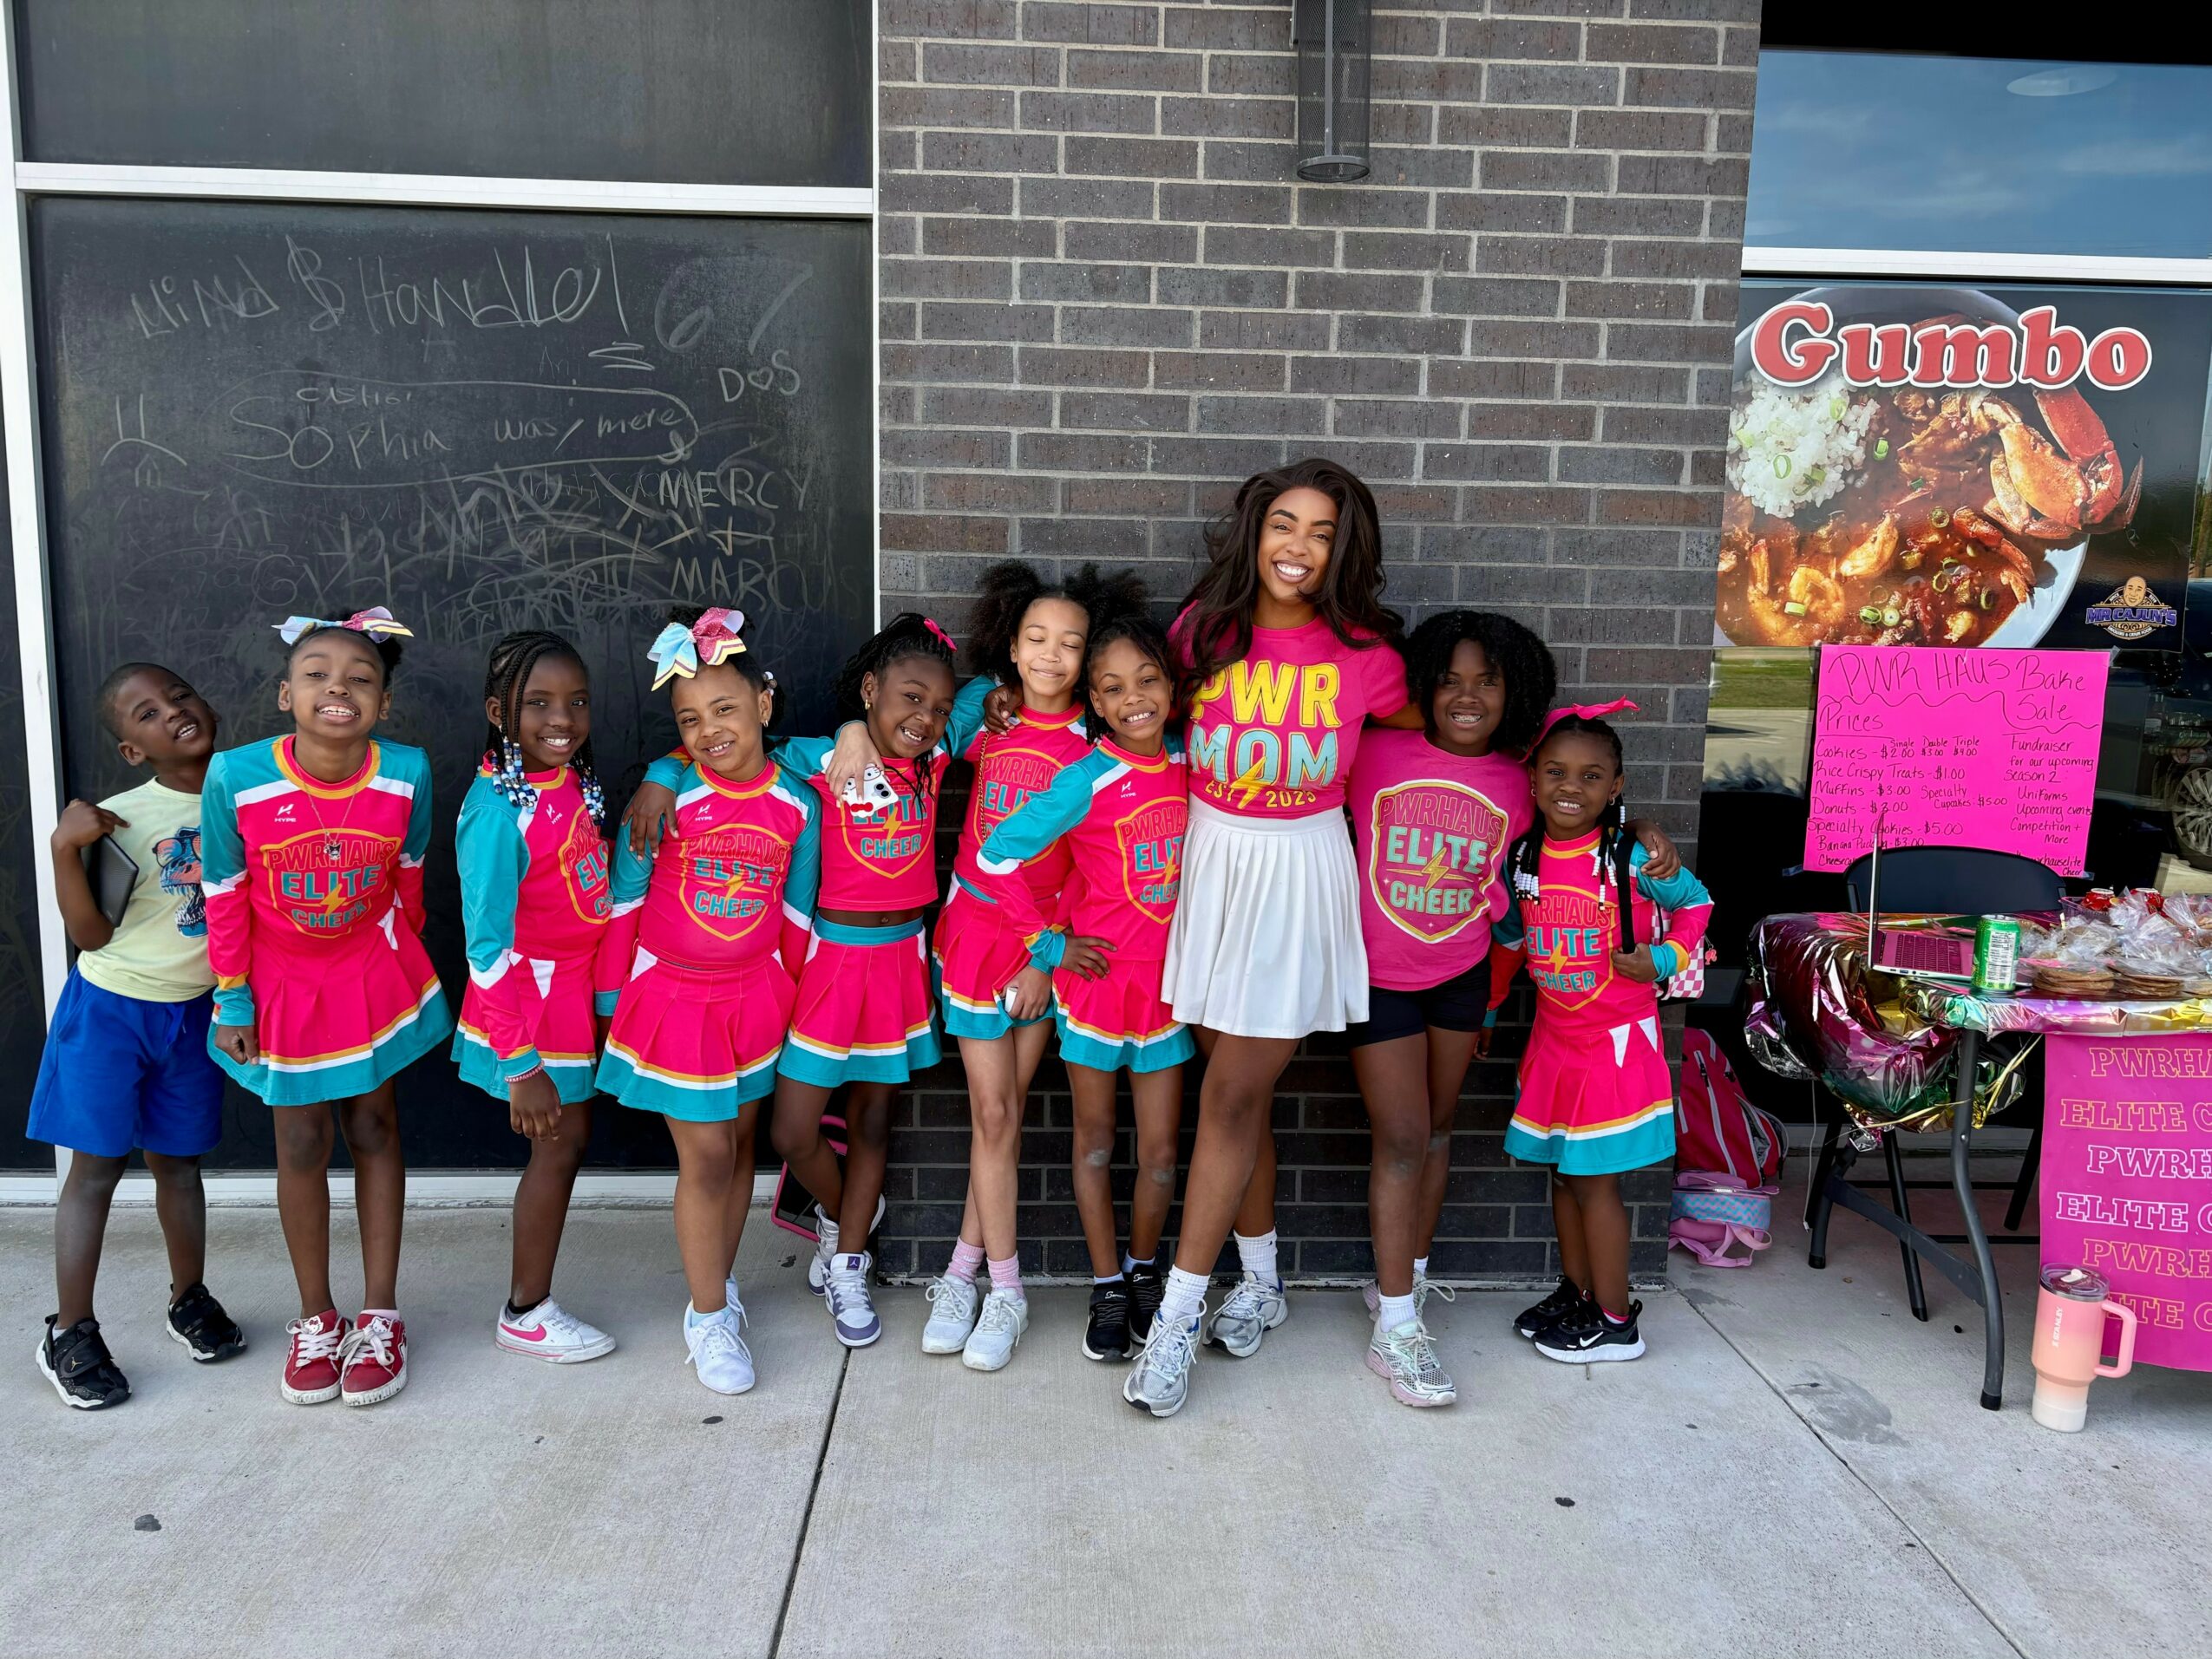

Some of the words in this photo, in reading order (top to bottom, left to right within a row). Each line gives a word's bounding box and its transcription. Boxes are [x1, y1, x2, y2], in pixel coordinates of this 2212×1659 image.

[1751, 300, 2152, 391] Gumbo
[222, 395, 452, 470] Sophia
[659, 467, 811, 512] MERCY
[2085, 608, 2111, 624] MR
[2112, 608, 2177, 627] CAJUN'S
[1829, 651, 1921, 696] PWR
[1935, 653, 2011, 690] HAUS
[2016, 655, 2086, 692] Bake
[1190, 660, 1341, 728] PWR
[2017, 694, 2072, 721] Sale
[1820, 702, 1883, 731] Prices
[1816, 739, 1867, 760] Cookies
[1881, 744, 1914, 760] $2.00
[1890, 739, 1914, 749] Single
[1923, 736, 1947, 748] Double
[1953, 735, 1980, 746] Triple
[2004, 733, 2074, 752] Fundraiser
[1188, 723, 1338, 790] MOM
[2010, 755, 2024, 767] for
[2030, 758, 2044, 767] our
[2048, 758, 2094, 772] upcoming
[1814, 760, 1843, 778] Rice
[1847, 762, 1883, 781] Crispy
[1887, 763, 1924, 779] Treats
[1934, 765, 1965, 781] $1.00
[2004, 769, 2045, 781] Season
[2048, 771, 2062, 783] 2
[1205, 781, 1235, 802] EST
[1815, 781, 1864, 796] Muffins
[1876, 783, 1911, 796] $3.00
[1921, 784, 1967, 800] Specialty
[1978, 794, 2007, 807] $5.00
[1812, 797, 1856, 814] Donuts
[2016, 804, 2064, 822] Upcoming
[2067, 805, 2092, 816] events
[1378, 793, 1502, 846] PWRHAUS
[1808, 818, 1864, 838] Specialty
[1924, 821, 1963, 835] $5.00
[2010, 817, 2071, 834] Competition
[684, 833, 788, 866] PWRHAUS
[861, 833, 922, 859] CHEER
[1386, 825, 1489, 874] ELITE
[1816, 835, 1852, 851] Banana
[2045, 834, 2068, 844] More
[268, 839, 396, 872] PWRHAUS
[281, 865, 382, 900] ELITE
[693, 857, 776, 886] ELITE
[694, 890, 765, 918] CHEER
[1390, 880, 1474, 915] CHEER
[291, 901, 367, 927] CHEER
[1525, 926, 1602, 957] ELITE
[1533, 969, 1597, 992] CHEER
[2089, 1047, 2212, 1078] PWRH
[2060, 1098, 2187, 1131] ELITE
[2056, 1192, 2189, 1232] ELITE
